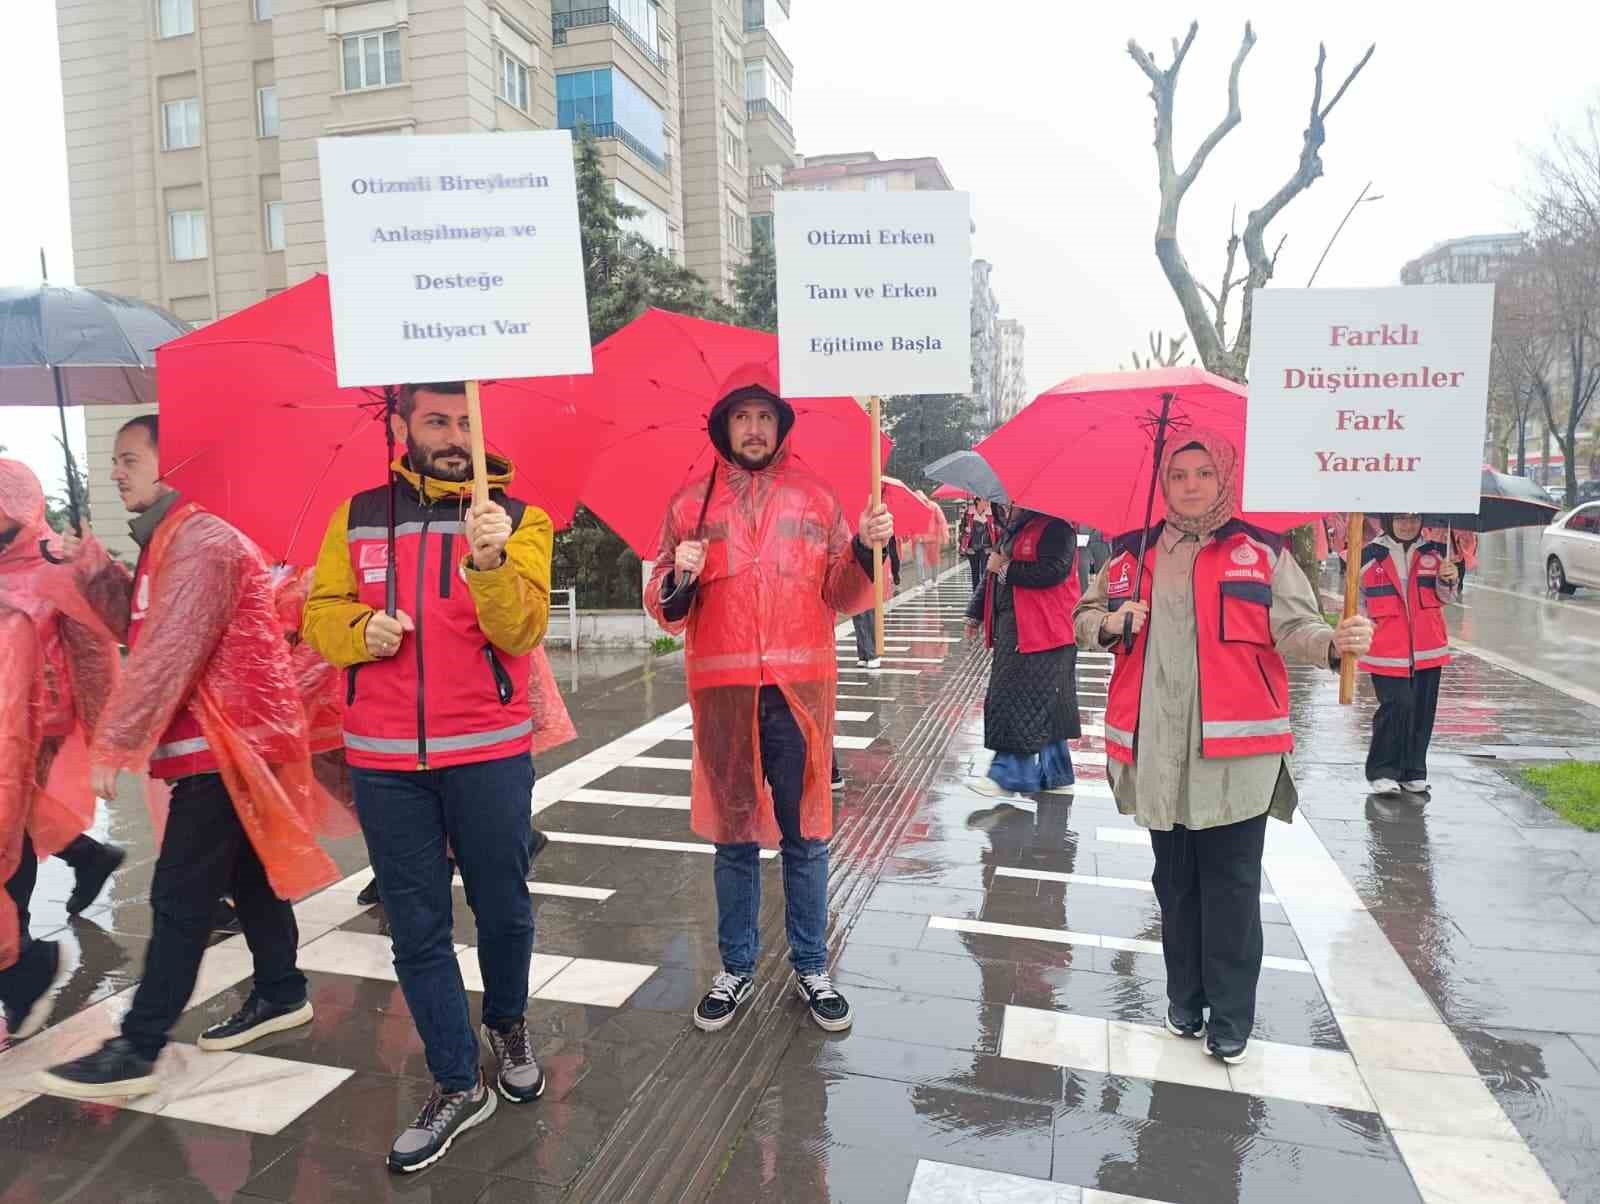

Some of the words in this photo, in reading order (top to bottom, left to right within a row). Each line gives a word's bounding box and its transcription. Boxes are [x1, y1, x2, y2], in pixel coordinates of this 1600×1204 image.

[511, 224, 537, 238] ve
[807, 229, 871, 246] Otizmi
[878, 229, 935, 245] Erken
[414, 271, 503, 291] Desteğe
[806, 284, 848, 299] Tanı
[854, 286, 874, 299] ve
[881, 283, 937, 298] Erken
[402, 320, 487, 342] İhtiyacı
[493, 319, 530, 335] Var
[1329, 323, 1421, 347] Farklı
[809, 336, 883, 355] Eğitime
[892, 336, 942, 354] Başla
[1283, 366, 1465, 393] Düşünenler
[1336, 409, 1405, 431] Fark
[1315, 451, 1421, 473] Yaratır
